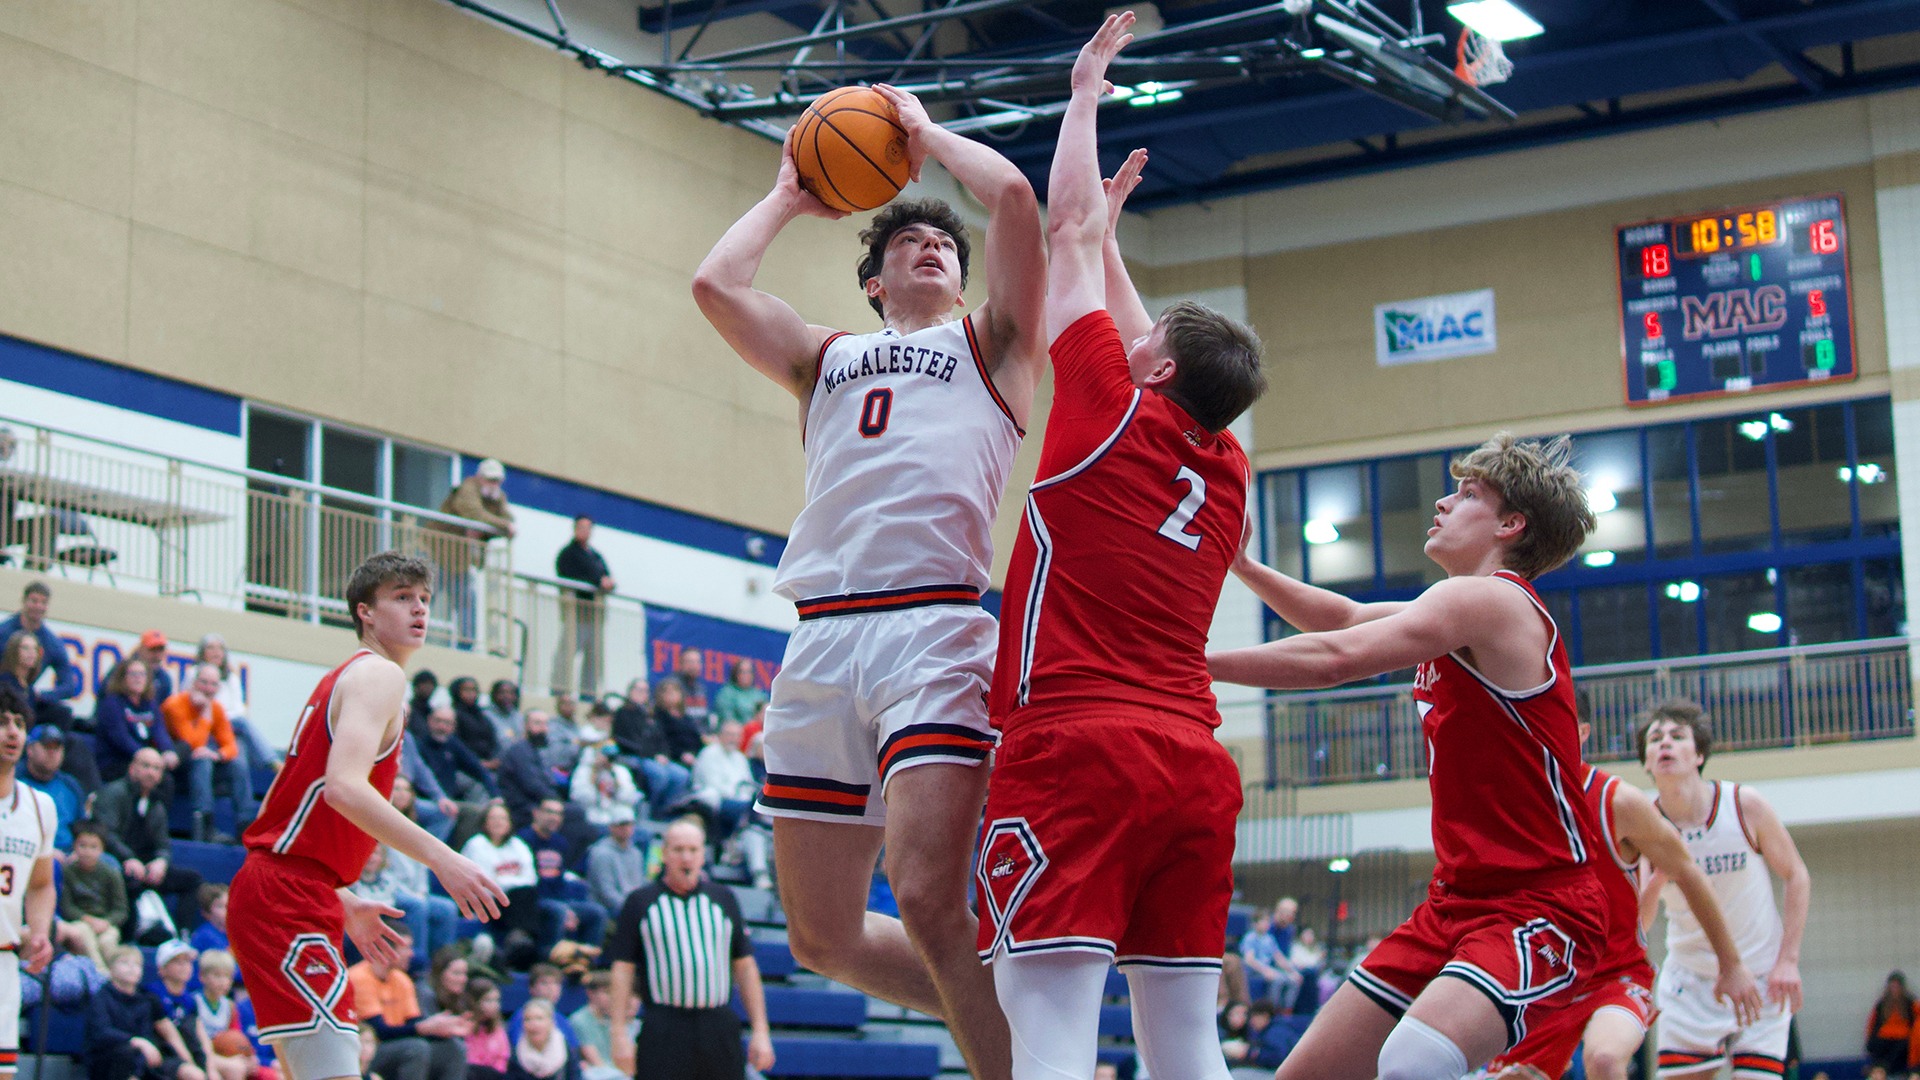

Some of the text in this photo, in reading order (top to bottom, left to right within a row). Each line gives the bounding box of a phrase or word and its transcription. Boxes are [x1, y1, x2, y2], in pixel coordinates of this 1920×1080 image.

[1692, 211, 1777, 253] 10:58
[1809, 219, 1838, 254] 16
[1642, 244, 1670, 278] 18
[1681, 285, 1787, 341] MAC
[1807, 289, 1827, 318] 5
[1643, 312, 1663, 339] 5
[824, 345, 958, 394] MACALESTER
[858, 387, 894, 438] 0
[1157, 465, 1206, 552] 2
